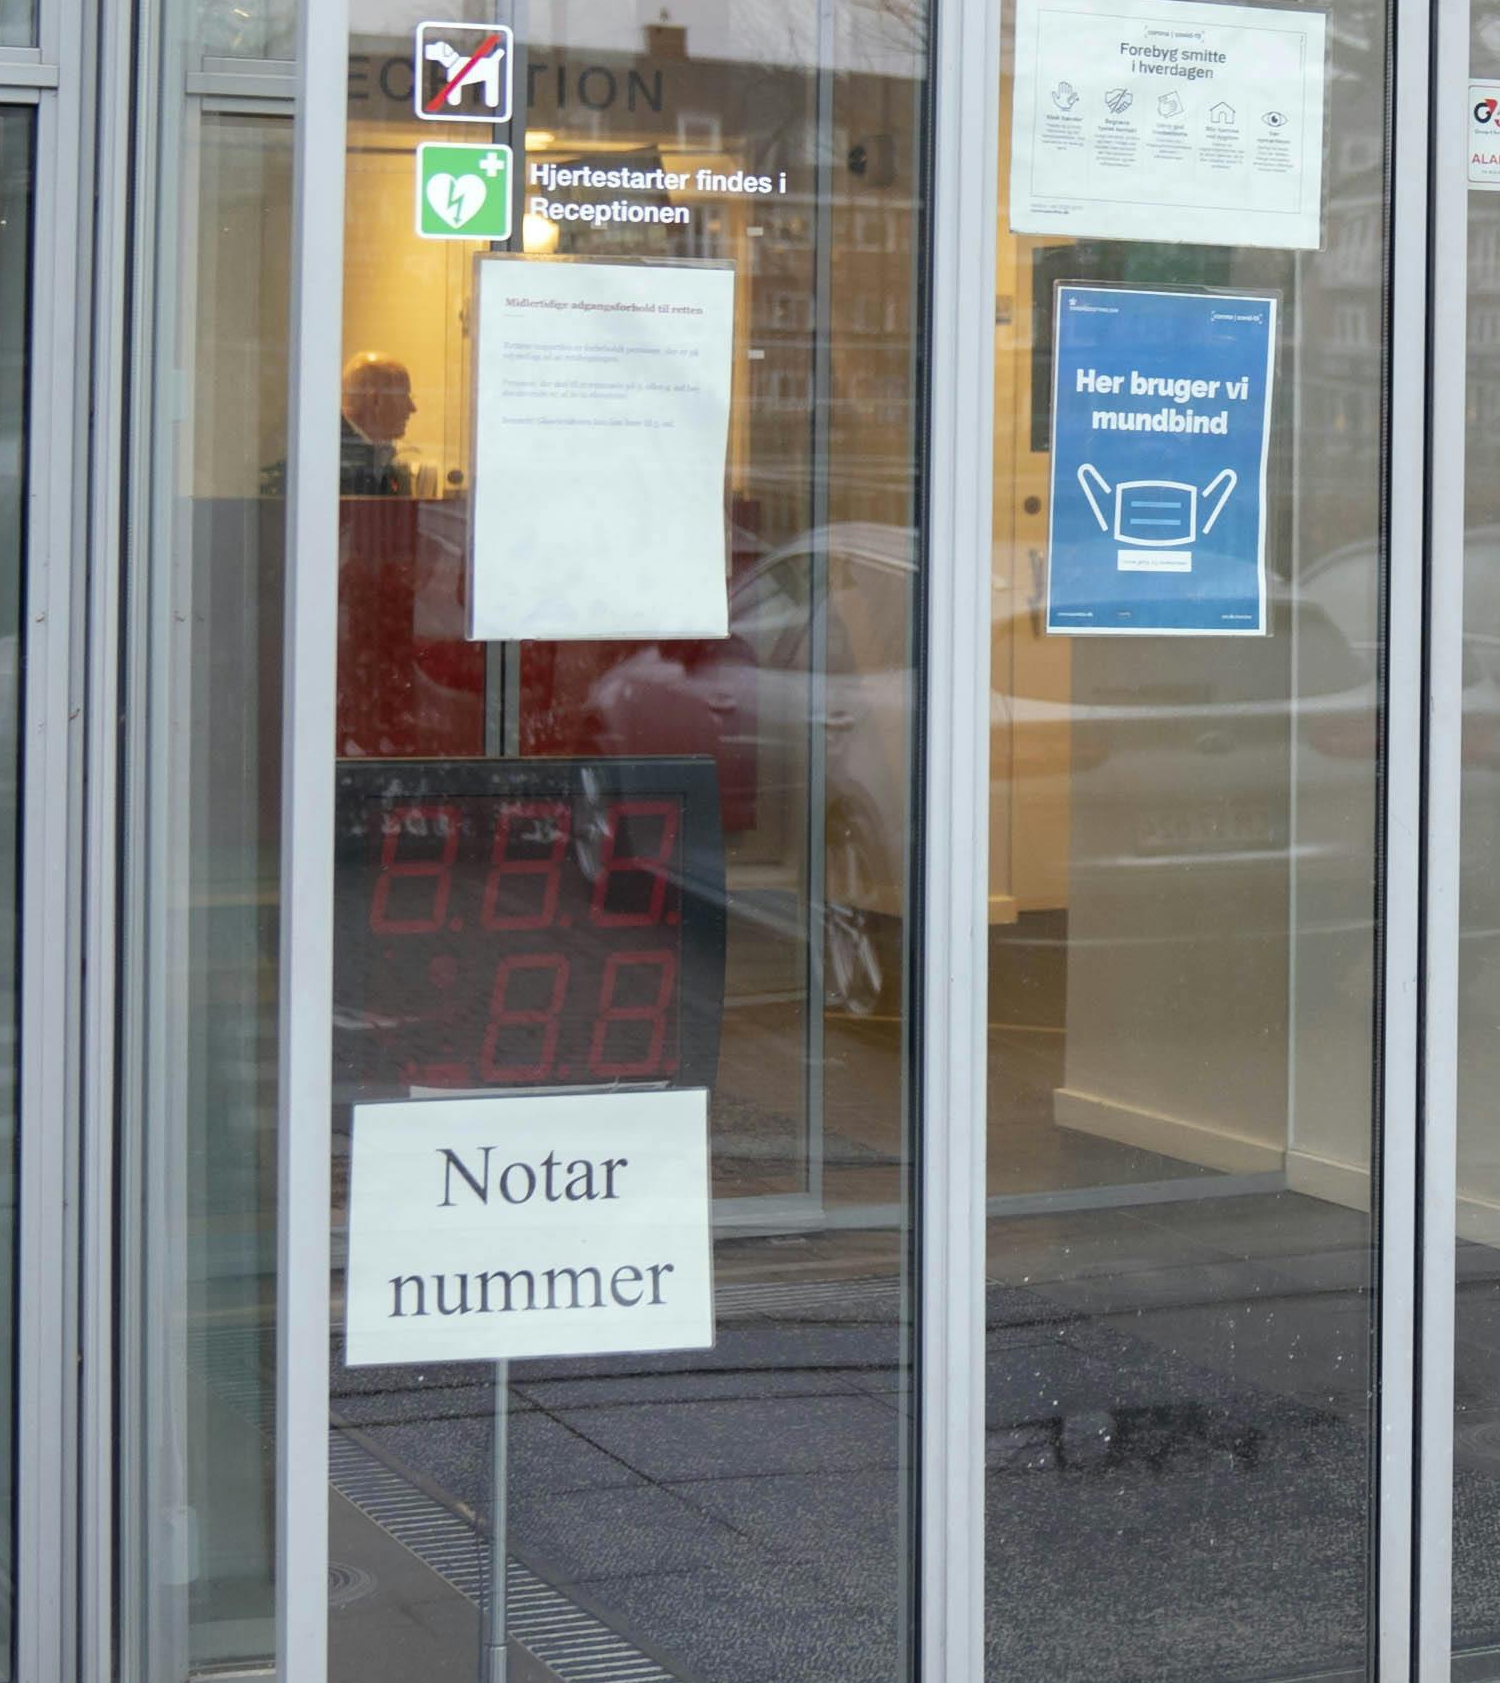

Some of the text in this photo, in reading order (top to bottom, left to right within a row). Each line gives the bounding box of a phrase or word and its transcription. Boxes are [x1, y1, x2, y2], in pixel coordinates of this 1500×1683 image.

[1120, 42, 1227, 64] Forebyg smitte
[1131, 60, 1214, 80] i hverdagen
[528, 162, 787, 195] Hjertestarter findes i
[528, 199, 690, 227] Receptionen
[1076, 368, 1249, 404] Her bruger vi
[1091, 408, 1229, 436] mundbind
[434, 1144, 629, 1208] Notar
[388, 1260, 676, 1318] nummer
